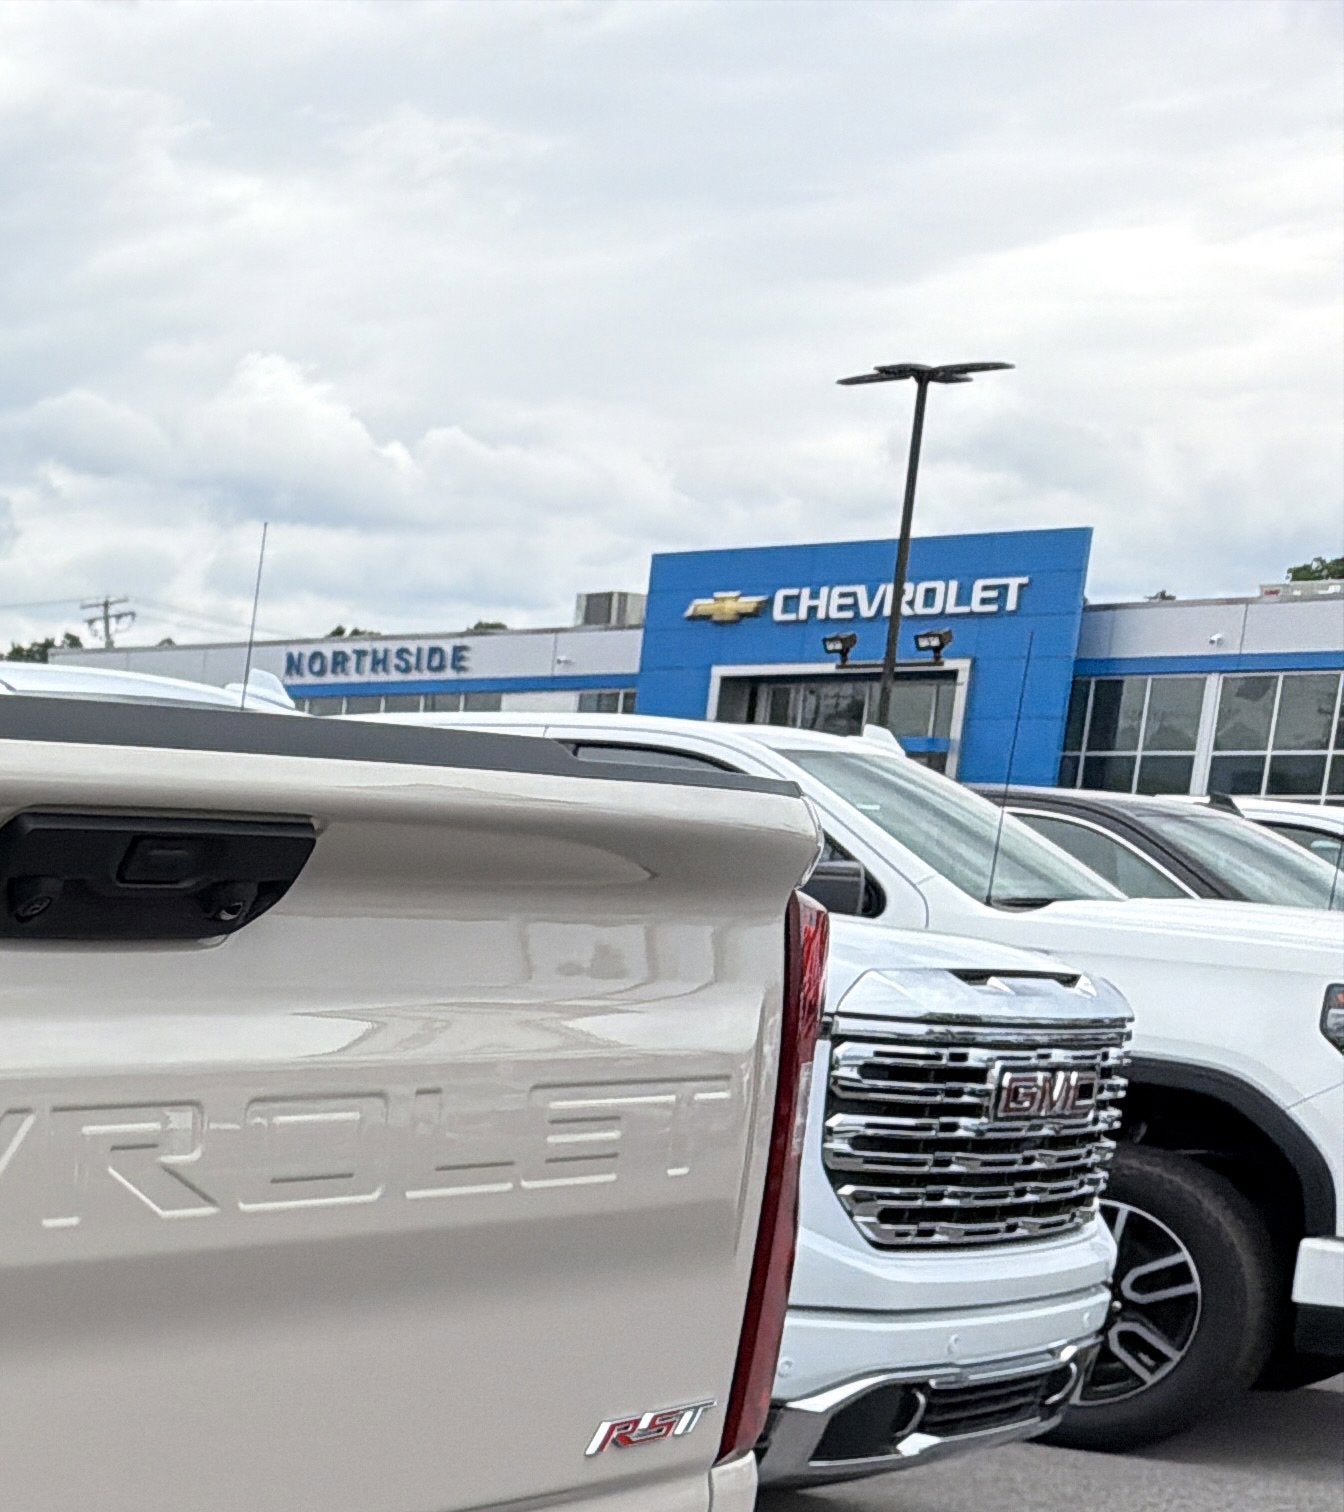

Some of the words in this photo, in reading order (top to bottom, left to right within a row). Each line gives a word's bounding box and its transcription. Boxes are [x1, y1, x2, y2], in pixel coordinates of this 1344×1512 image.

[772, 576, 1030, 622] CHEVROLET
[284, 645, 472, 678] NORTHSIDE
[997, 1071, 1096, 1119] GMC
[584, 1399, 718, 1457] RST
